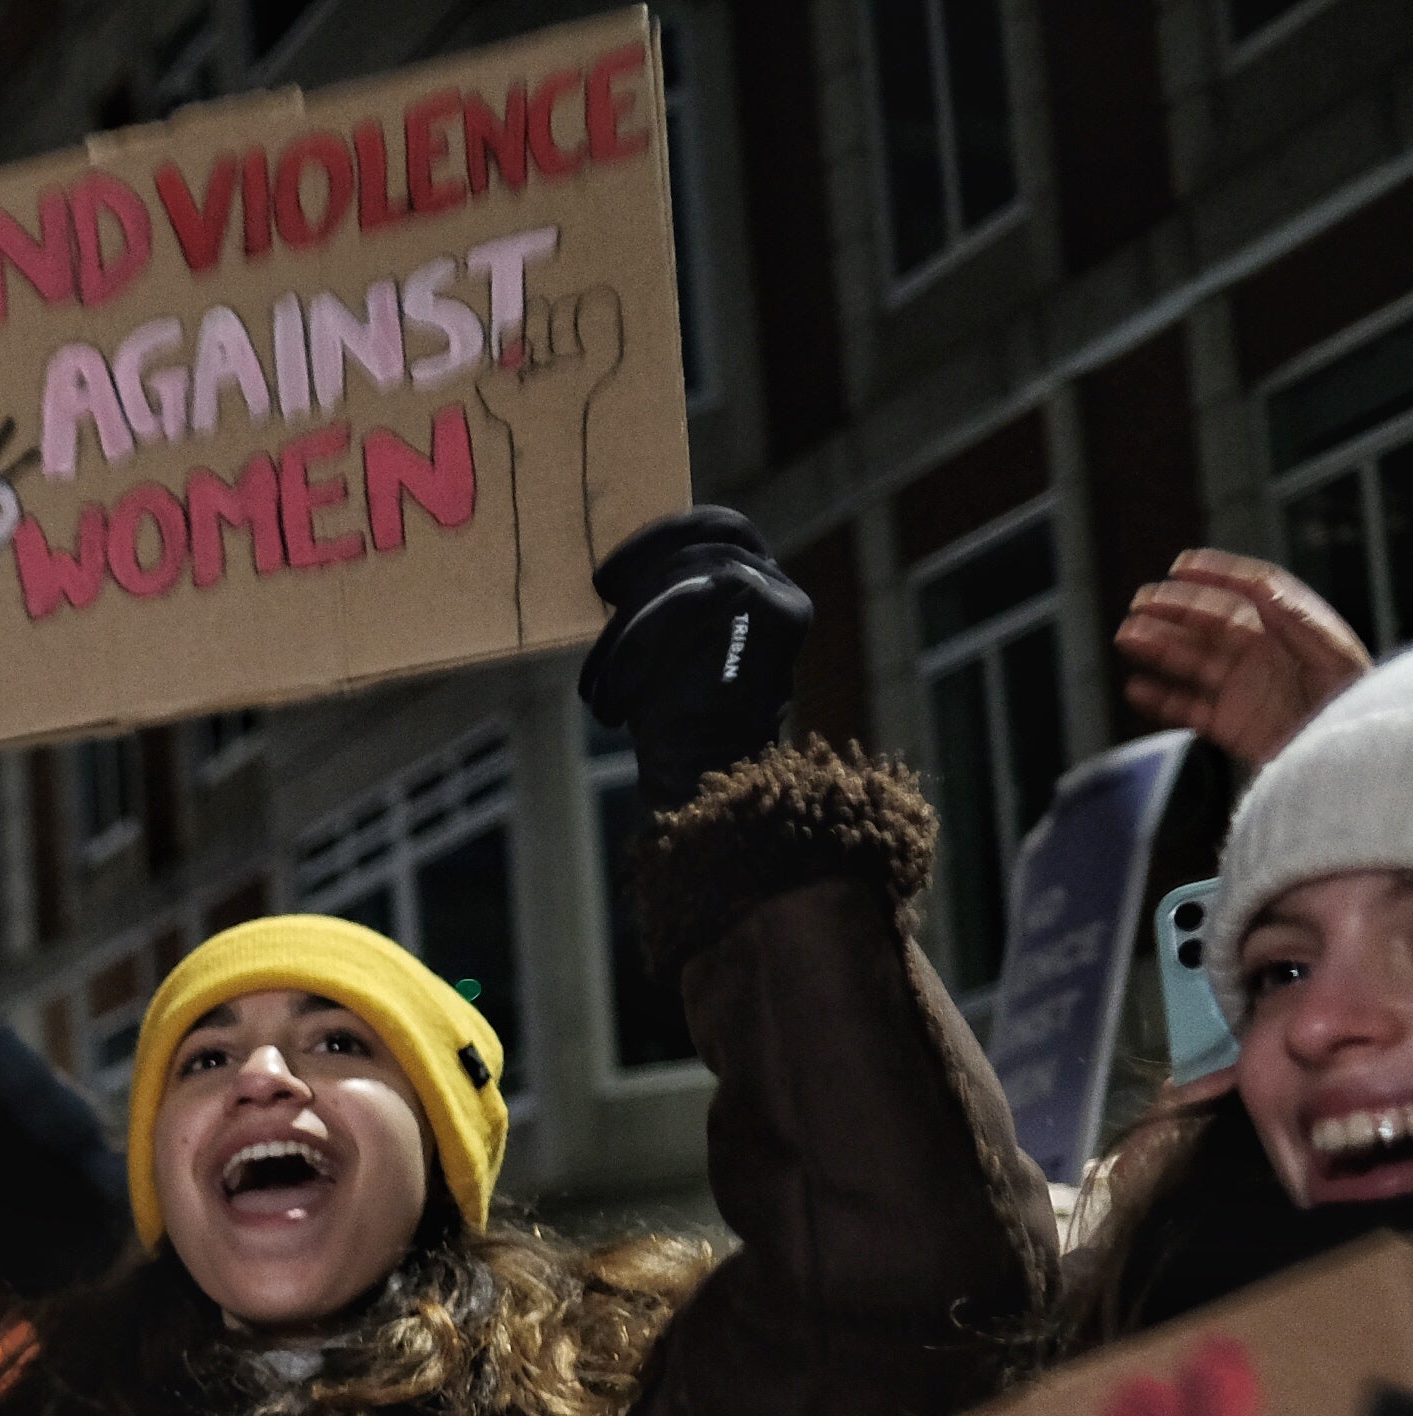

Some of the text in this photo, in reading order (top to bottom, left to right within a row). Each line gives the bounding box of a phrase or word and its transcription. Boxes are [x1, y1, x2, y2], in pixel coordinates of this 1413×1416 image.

[152, 43, 651, 274] VIOLENCE
[39, 226, 559, 480] AGAINST
[14, 403, 478, 621] WOMEN
[721, 611, 750, 684] TRIBAN
